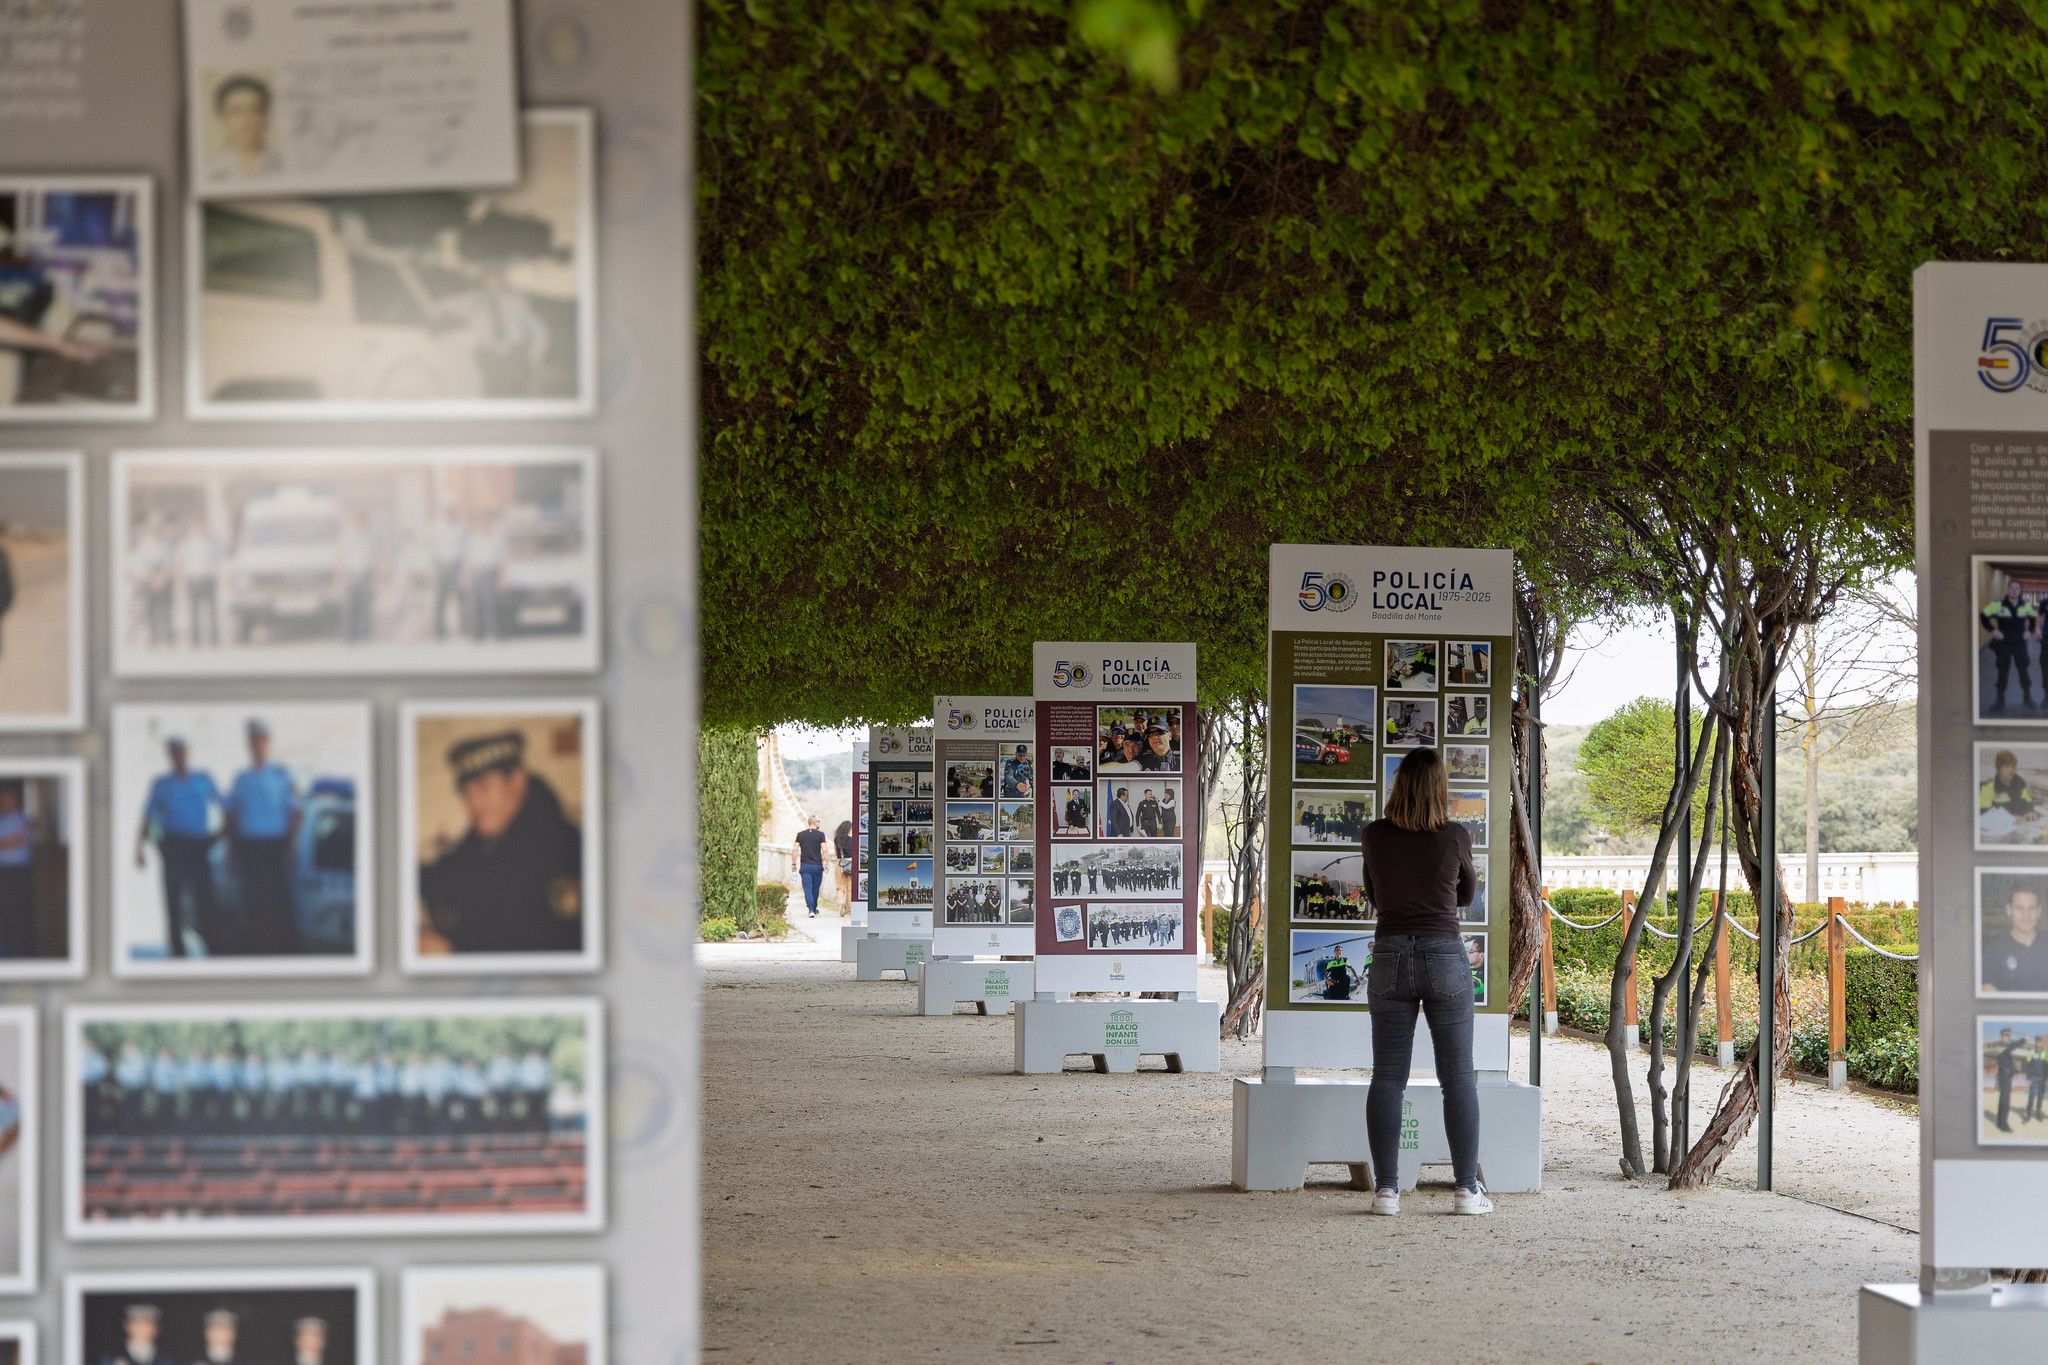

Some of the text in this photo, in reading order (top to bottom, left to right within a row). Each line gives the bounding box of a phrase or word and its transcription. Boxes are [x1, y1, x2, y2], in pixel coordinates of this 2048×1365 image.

[1971, 443, 1990, 454] Con
[1995, 443, 2004, 454] el
[2008, 443, 2032, 454] paso
[1971, 456, 1980, 466] la
[2022, 456, 2034, 466] de
[1971, 468, 2000, 478] Monte
[2003, 468, 2014, 478] se
[2017, 468, 2027, 478] va
[1972, 480, 1979, 490] la
[1972, 518, 2046, 527] en los cuerpos
[1372, 568, 1474, 590] POLICÍA
[1372, 591, 1491, 610] LOCAL 1975-2025
[1372, 611, 1442, 621] Boadilla del Monte
[1102, 657, 1170, 672] POLICÍA
[1102, 674, 1150, 686] LOCAL
[985, 706, 1034, 718] POLICÍA
[985, 719, 1020, 728] LOCAL
